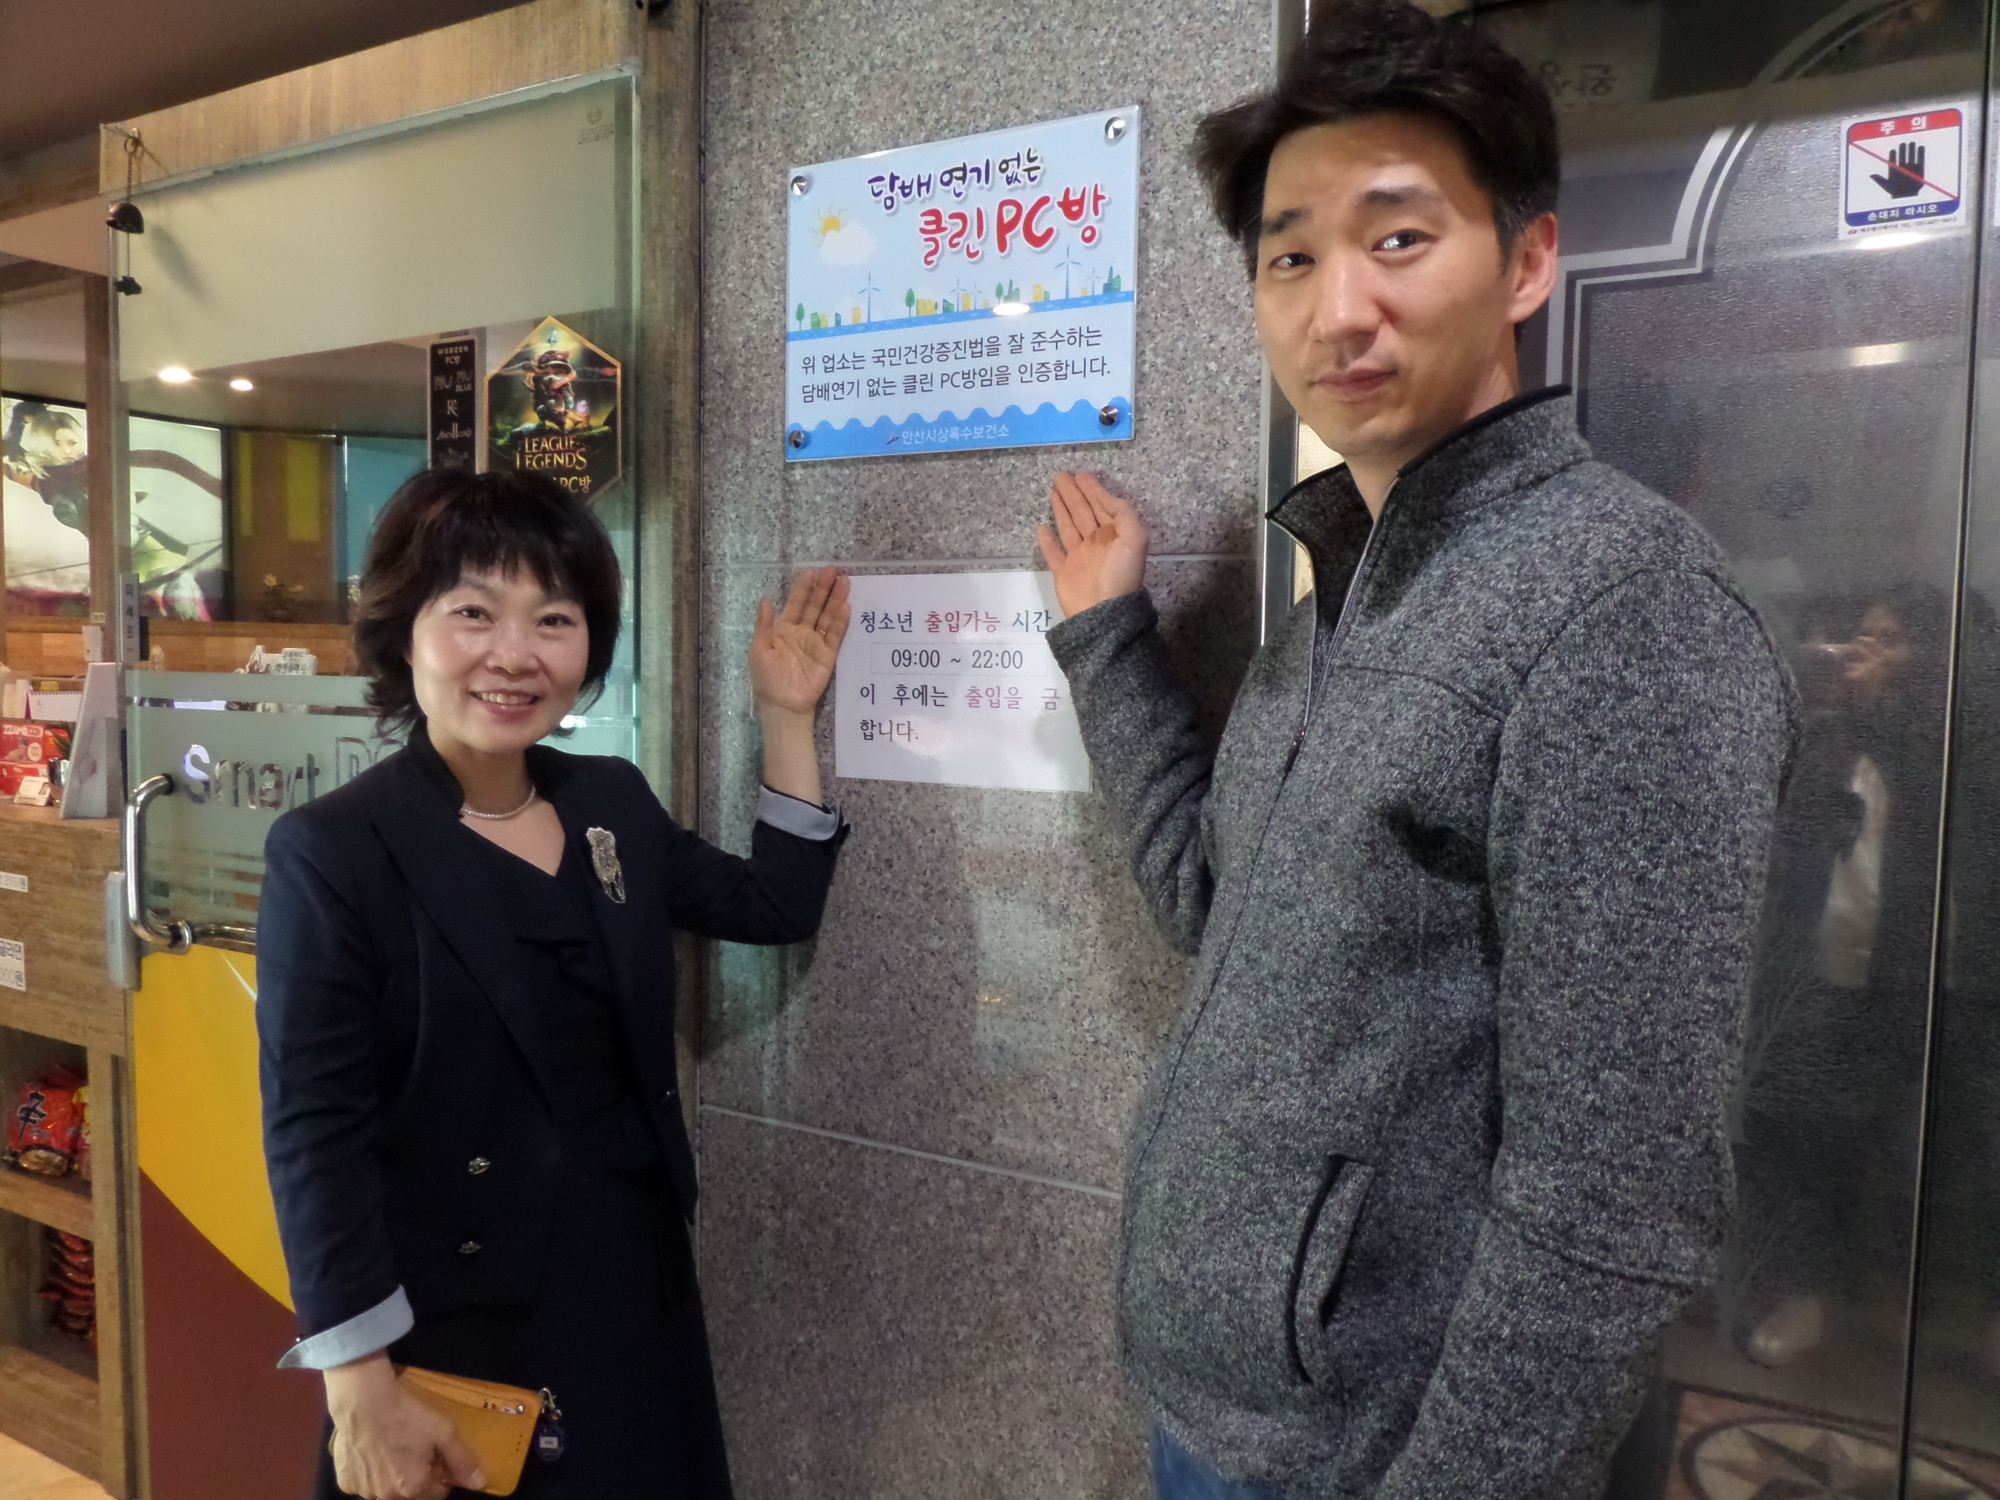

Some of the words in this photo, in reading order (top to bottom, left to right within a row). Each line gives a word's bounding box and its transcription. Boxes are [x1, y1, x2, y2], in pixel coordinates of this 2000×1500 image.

[867, 171, 932, 211] 담배
[939, 158, 990, 198] 연기
[998, 147, 1042, 186] 없는
[919, 206, 985, 266] 클린
[996, 183, 1107, 253] PC방
[1867, 208, 1899, 222] 손대지
[1904, 203, 1938, 217] 마시오
[801, 355, 816, 375] 위
[821, 351, 866, 373] 업소는
[871, 334, 1001, 368] 국민건강증진법을
[1007, 332, 1025, 355] 잘
[1030, 325, 1103, 352] 준수하는
[801, 379, 860, 404] 담배연기
[866, 376, 897, 398] 없는
[902, 372, 934, 394] 클린
[940, 364, 1012, 390] PC방임을
[1017, 355, 1111, 384] 인증합니다.
[524, 435, 577, 453] LEAGUE
[515, 447, 588, 471] LEGENDS
[860, 610, 913, 634] 청소년
[924, 610, 1001, 633] 출입가능
[1012, 609, 1053, 633] 시간
[891, 649, 940, 668] 09:00
[971, 650, 1023, 669] 22:00
[860, 683, 875, 705] 이
[892, 683, 949, 707] 후에는
[965, 685, 1023, 710] 출입을
[1040, 687, 1061, 710] 금
[859, 719, 919, 742] 합니다.
